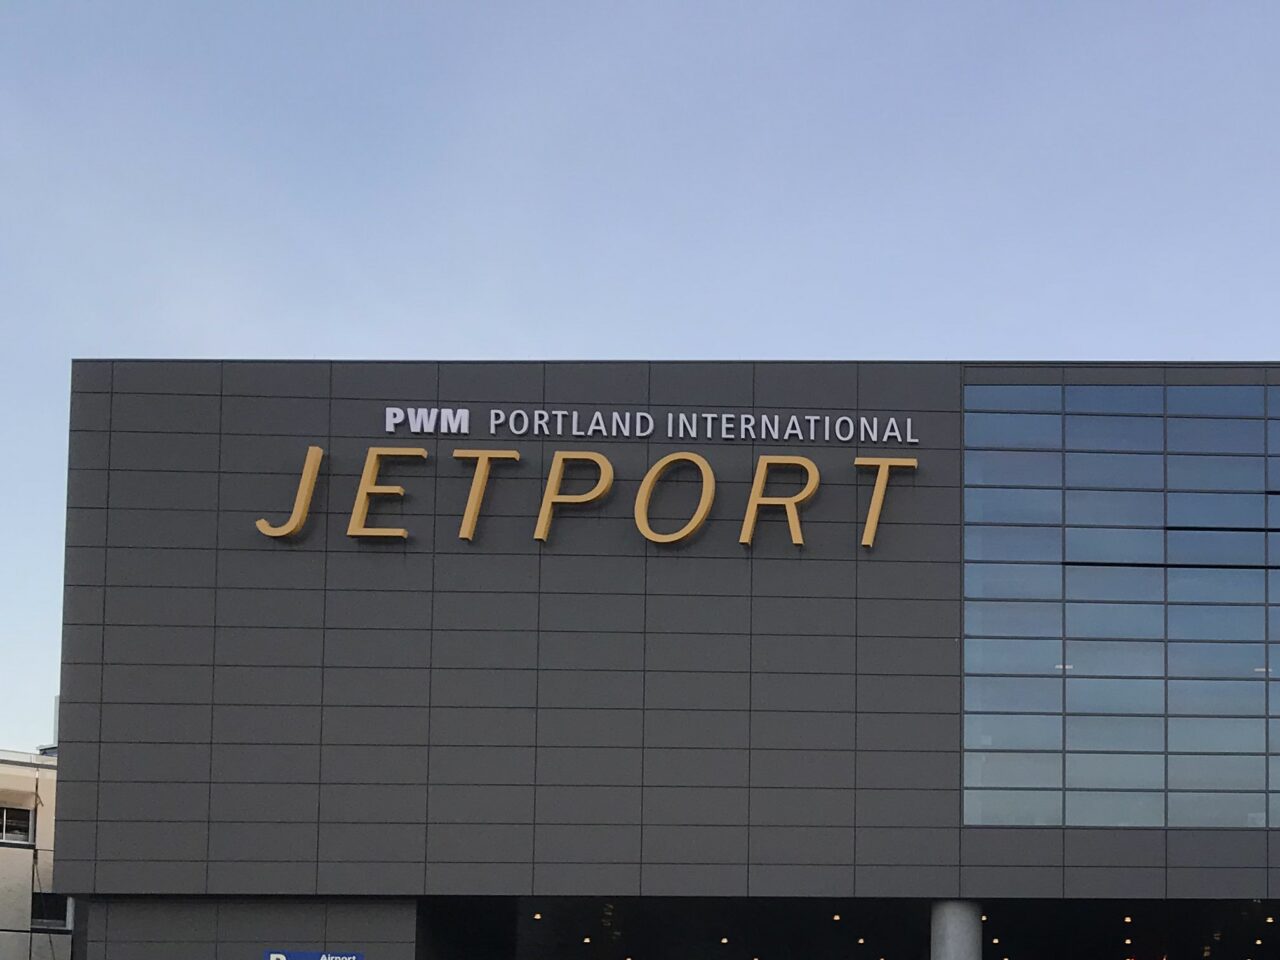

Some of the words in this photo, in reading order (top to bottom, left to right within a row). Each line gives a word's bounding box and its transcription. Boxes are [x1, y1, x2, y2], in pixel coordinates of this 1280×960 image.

[385, 407, 470, 434] PWM
[489, 409, 655, 437] PORTLAND
[667, 412, 920, 443] INTERNATIONAL
[255, 445, 920, 548] JETPORT
